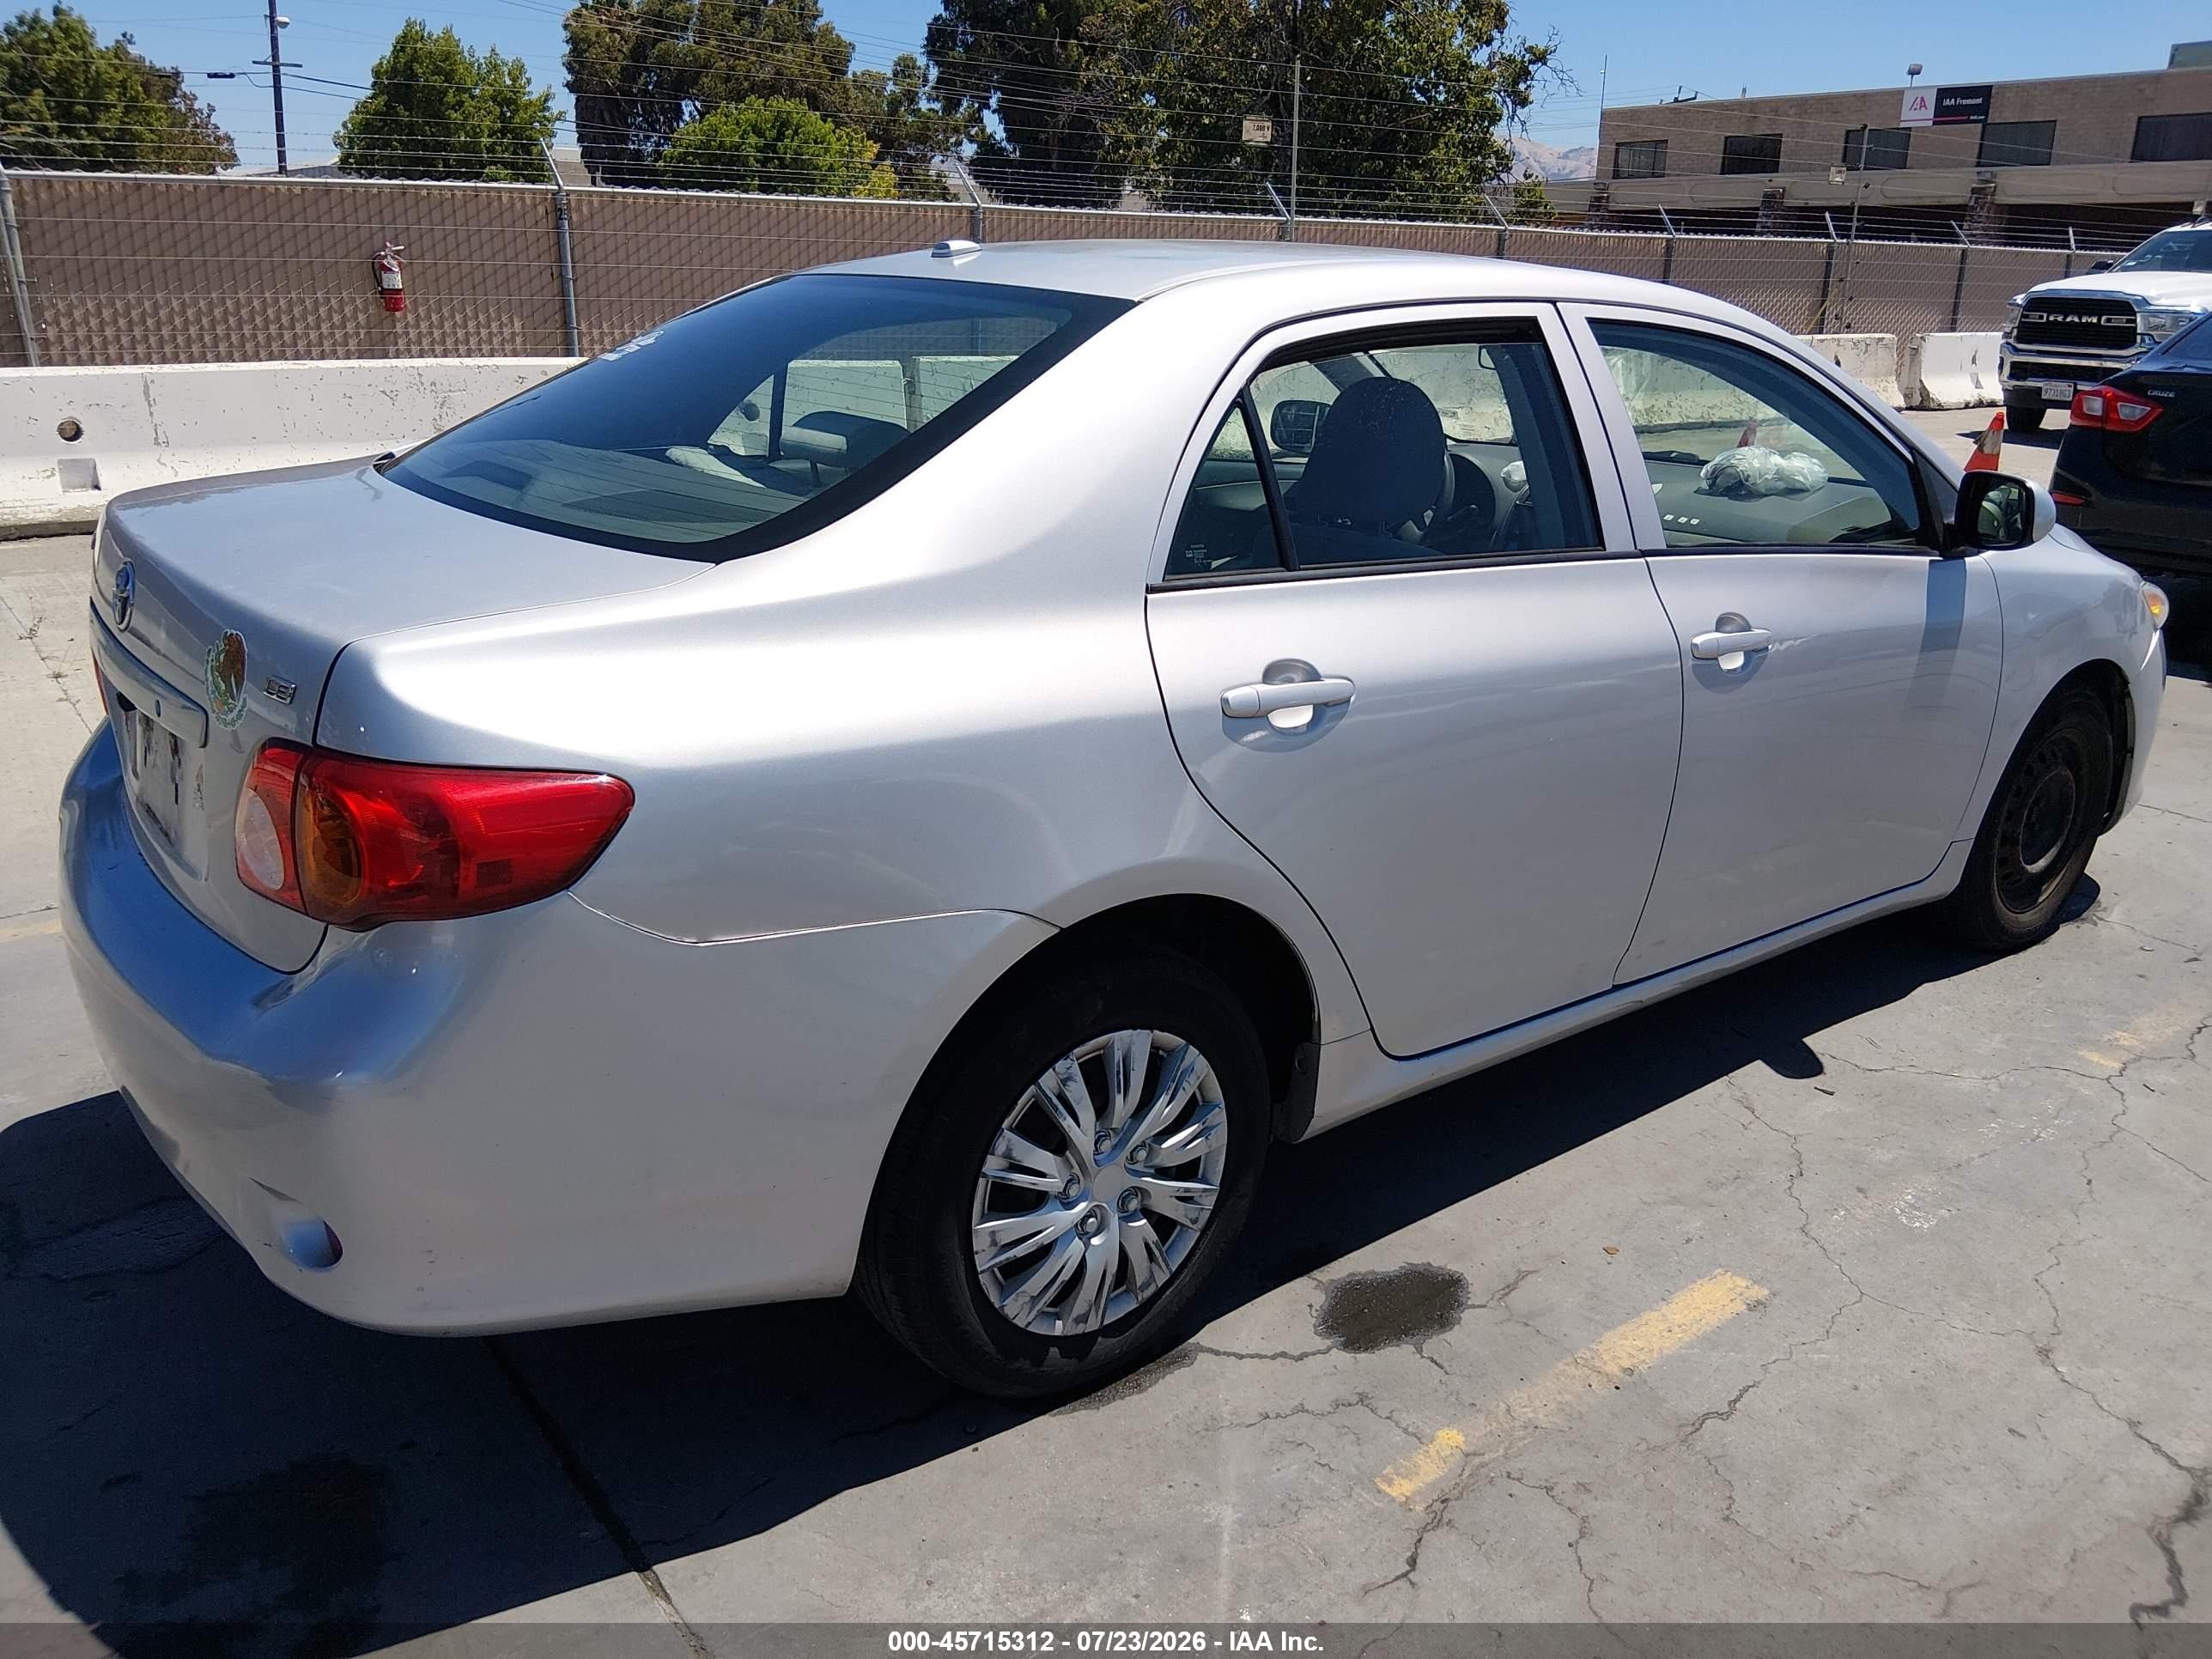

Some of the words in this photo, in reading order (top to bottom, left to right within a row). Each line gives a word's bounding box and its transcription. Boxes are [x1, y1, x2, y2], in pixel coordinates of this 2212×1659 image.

[1942, 98, 1955, 106] IAA
[2048, 314, 2098, 323] RAM
[2147, 389, 2176, 398] CRUZE
[263, 676, 296, 704] LE
